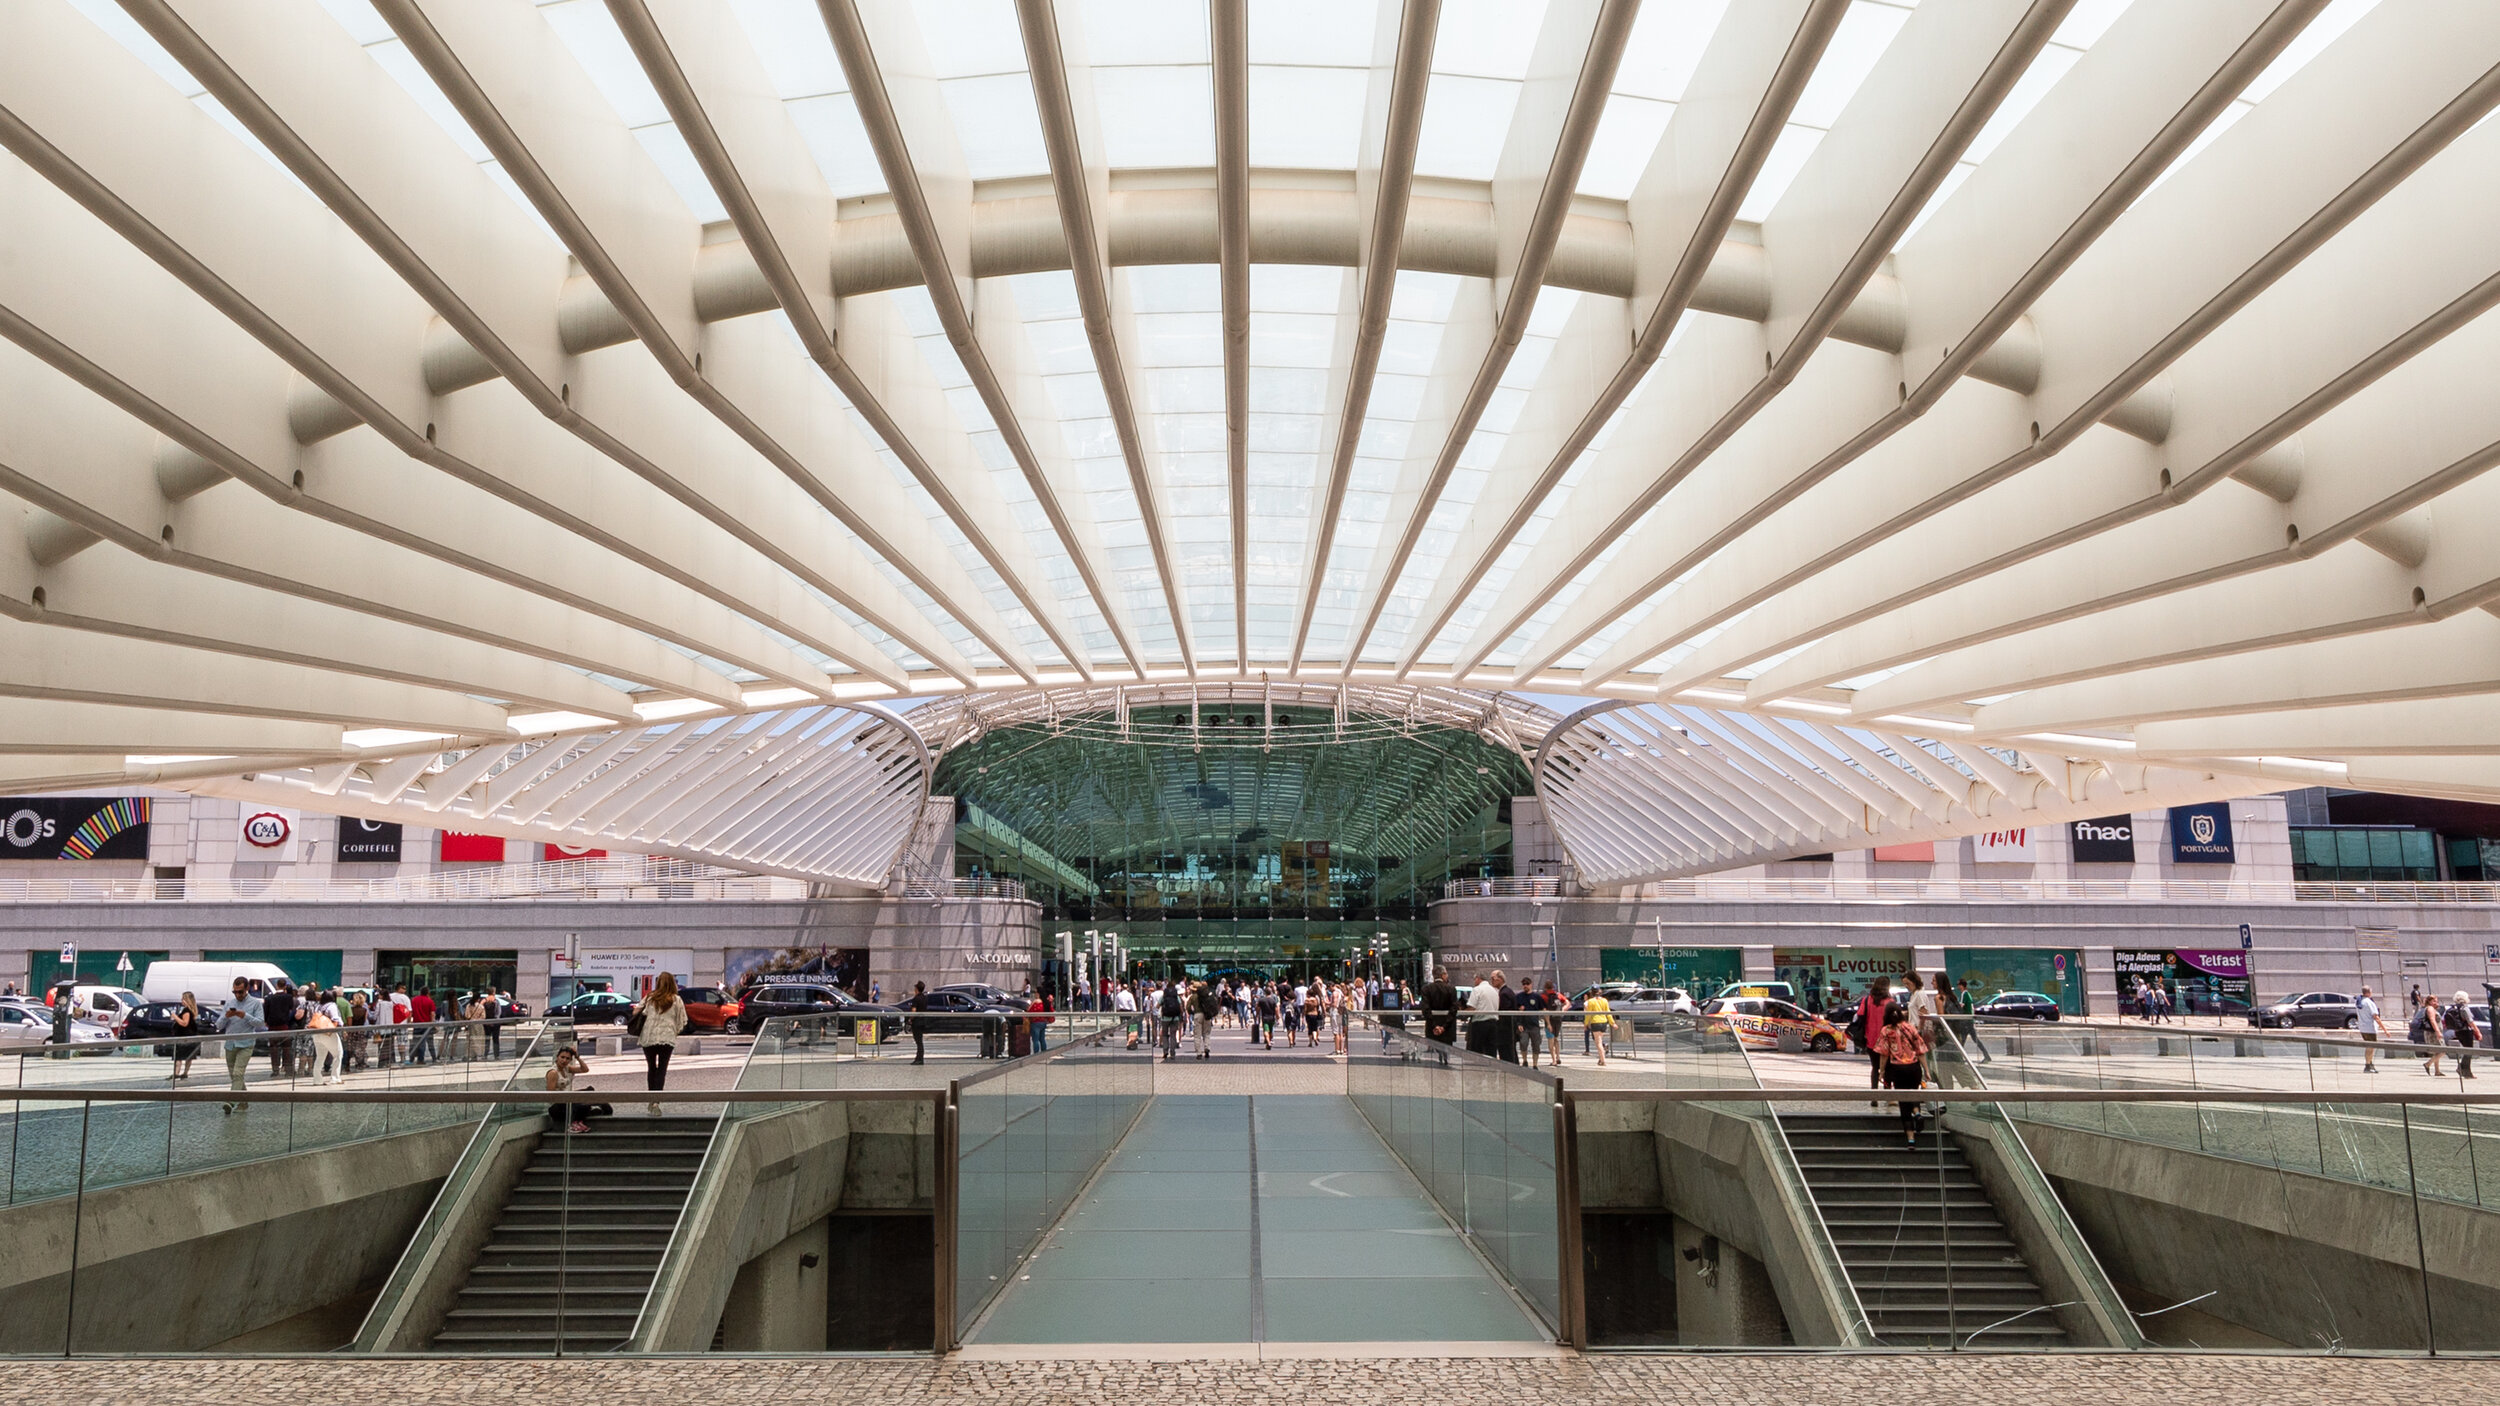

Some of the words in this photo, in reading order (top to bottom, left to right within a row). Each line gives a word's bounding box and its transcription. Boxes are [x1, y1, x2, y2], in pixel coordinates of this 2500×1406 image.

[252, 822, 280, 838] C&A
[2075, 822, 2131, 841] fnac
[342, 844, 396, 854] CORTEFIEL
[965, 953, 1000, 964] VASCO
[1461, 953, 1474, 963] DA
[1475, 952, 1509, 963] GAMA
[1638, 949, 1699, 958] CALEDONIA
[2116, 952, 2135, 963] Diga
[2135, 952, 2161, 962] Adeus
[1828, 955, 1907, 974] Levotuss
[2199, 954, 2242, 967] Telfast
[2127, 962, 2165, 974] Alergias!
[755, 975, 763, 983] A
[764, 975, 798, 983] PRESSA
[799, 972, 805, 983] É
[1761, 1022, 1813, 1041] ORIENTE
